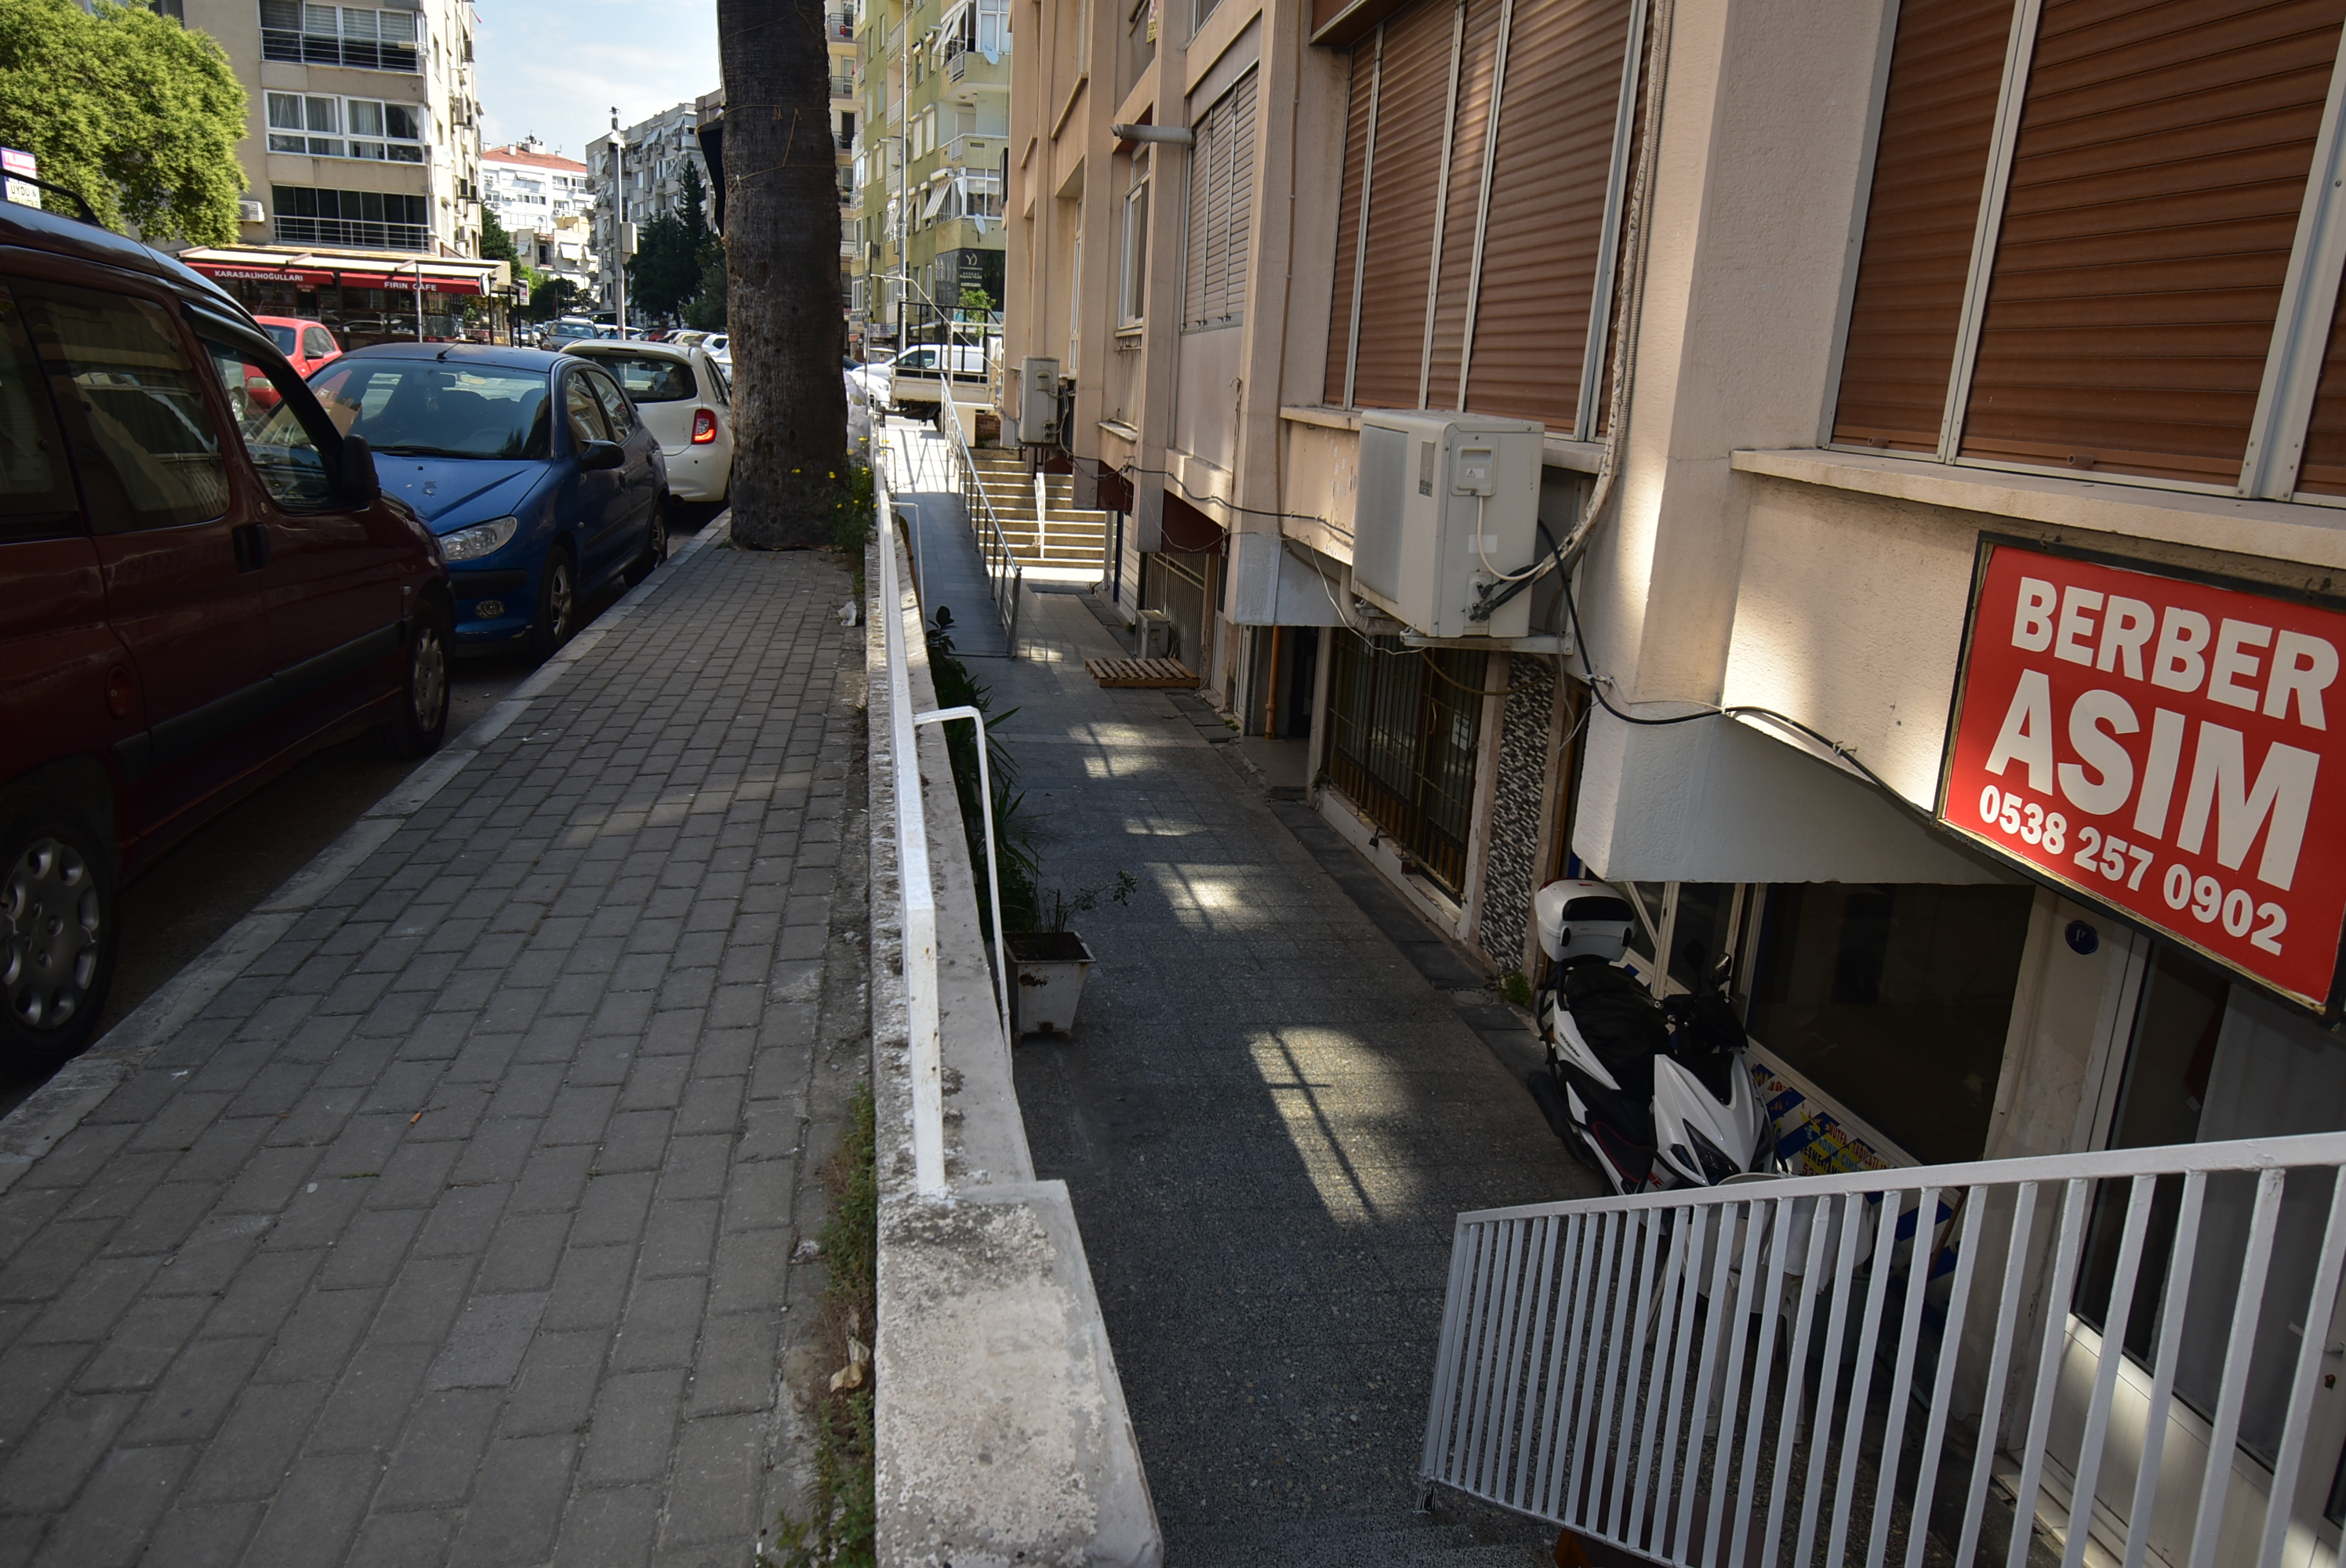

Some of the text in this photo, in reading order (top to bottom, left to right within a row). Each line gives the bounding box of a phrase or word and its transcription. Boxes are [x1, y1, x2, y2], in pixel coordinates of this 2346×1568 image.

[10, 184, 31, 197] UYDU
[412, 283, 437, 292] CAFE
[2011, 576, 2339, 731] BERBER
[1985, 668, 2321, 891] ASIM
[1979, 785, 2288, 956] 0538 257 0902
